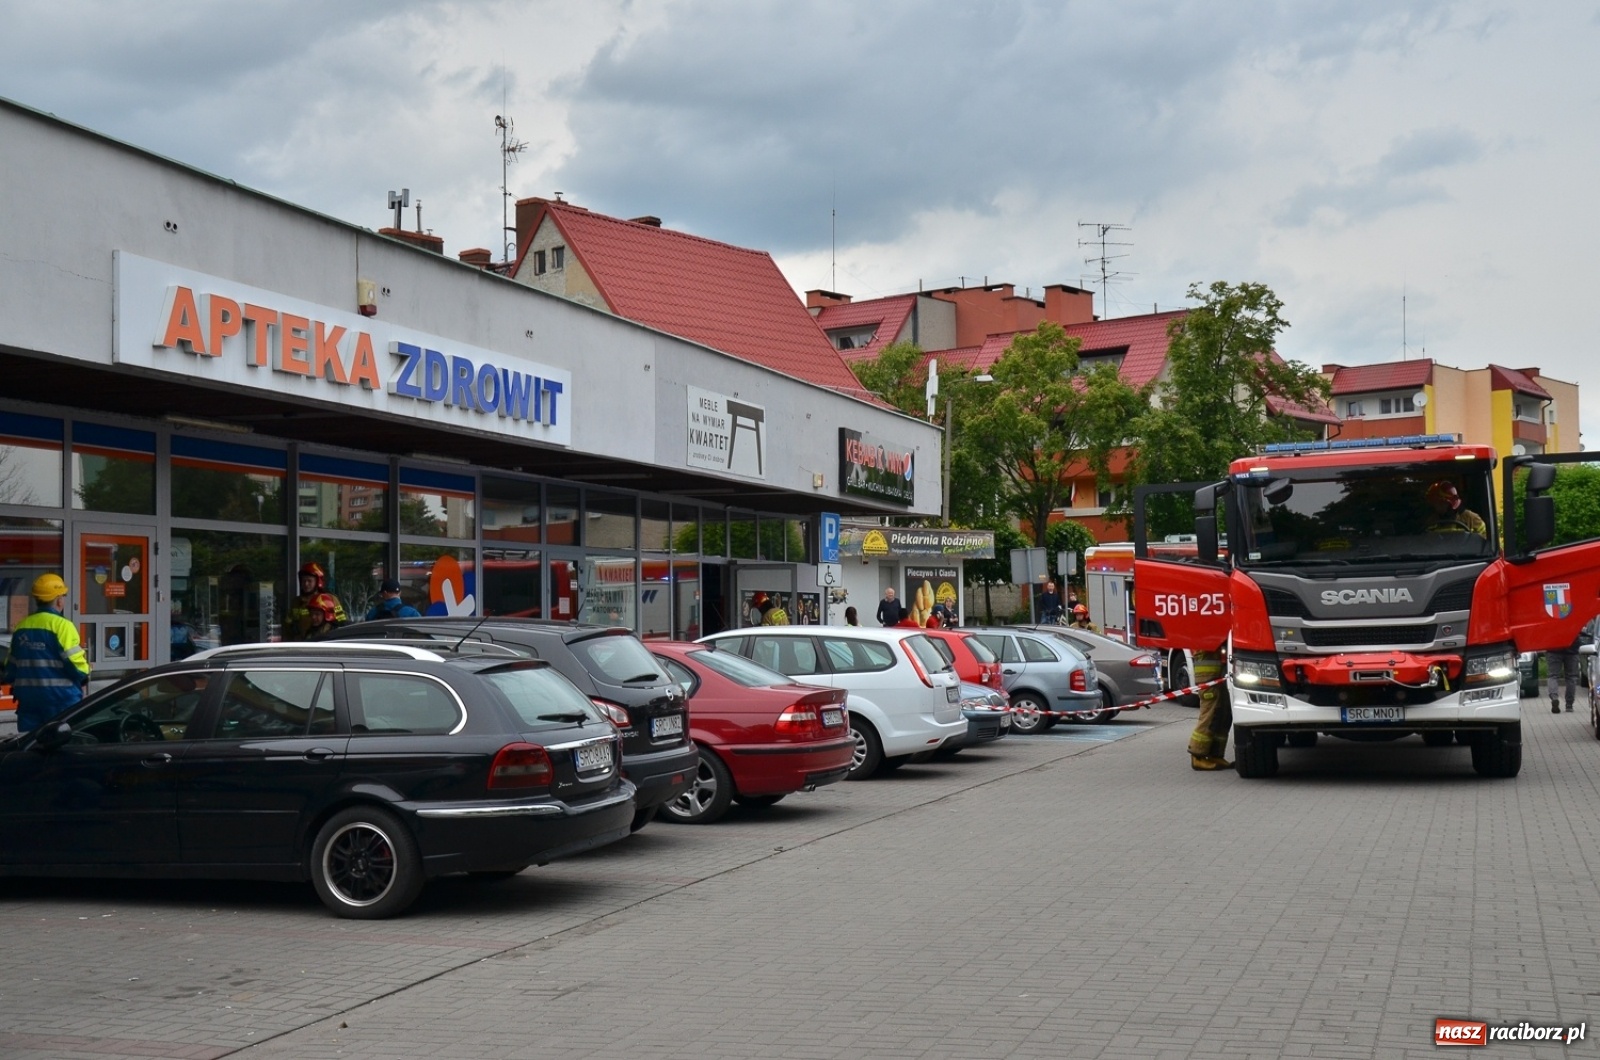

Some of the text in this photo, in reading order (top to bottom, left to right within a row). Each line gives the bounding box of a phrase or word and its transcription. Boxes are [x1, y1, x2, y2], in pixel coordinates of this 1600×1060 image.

[153, 286, 563, 426] APTEKA ZDROWIT
[699, 397, 718, 412] MEBLE
[691, 412, 725, 430] NA WYMIAR
[689, 428, 729, 451] KWARTET
[846, 438, 877, 468] KEBAB
[825, 516, 836, 550] P
[891, 533, 939, 545] Piekarnia
[907, 568, 934, 578] Pieczywo
[939, 569, 957, 577] Ciasta
[1154, 593, 1225, 616] 561 S 25
[1320, 587, 1414, 606] SCANIA
[1347, 708, 1400, 720] SRC MN01
[654, 718, 667, 733] SRC
[579, 748, 595, 766] SRC
